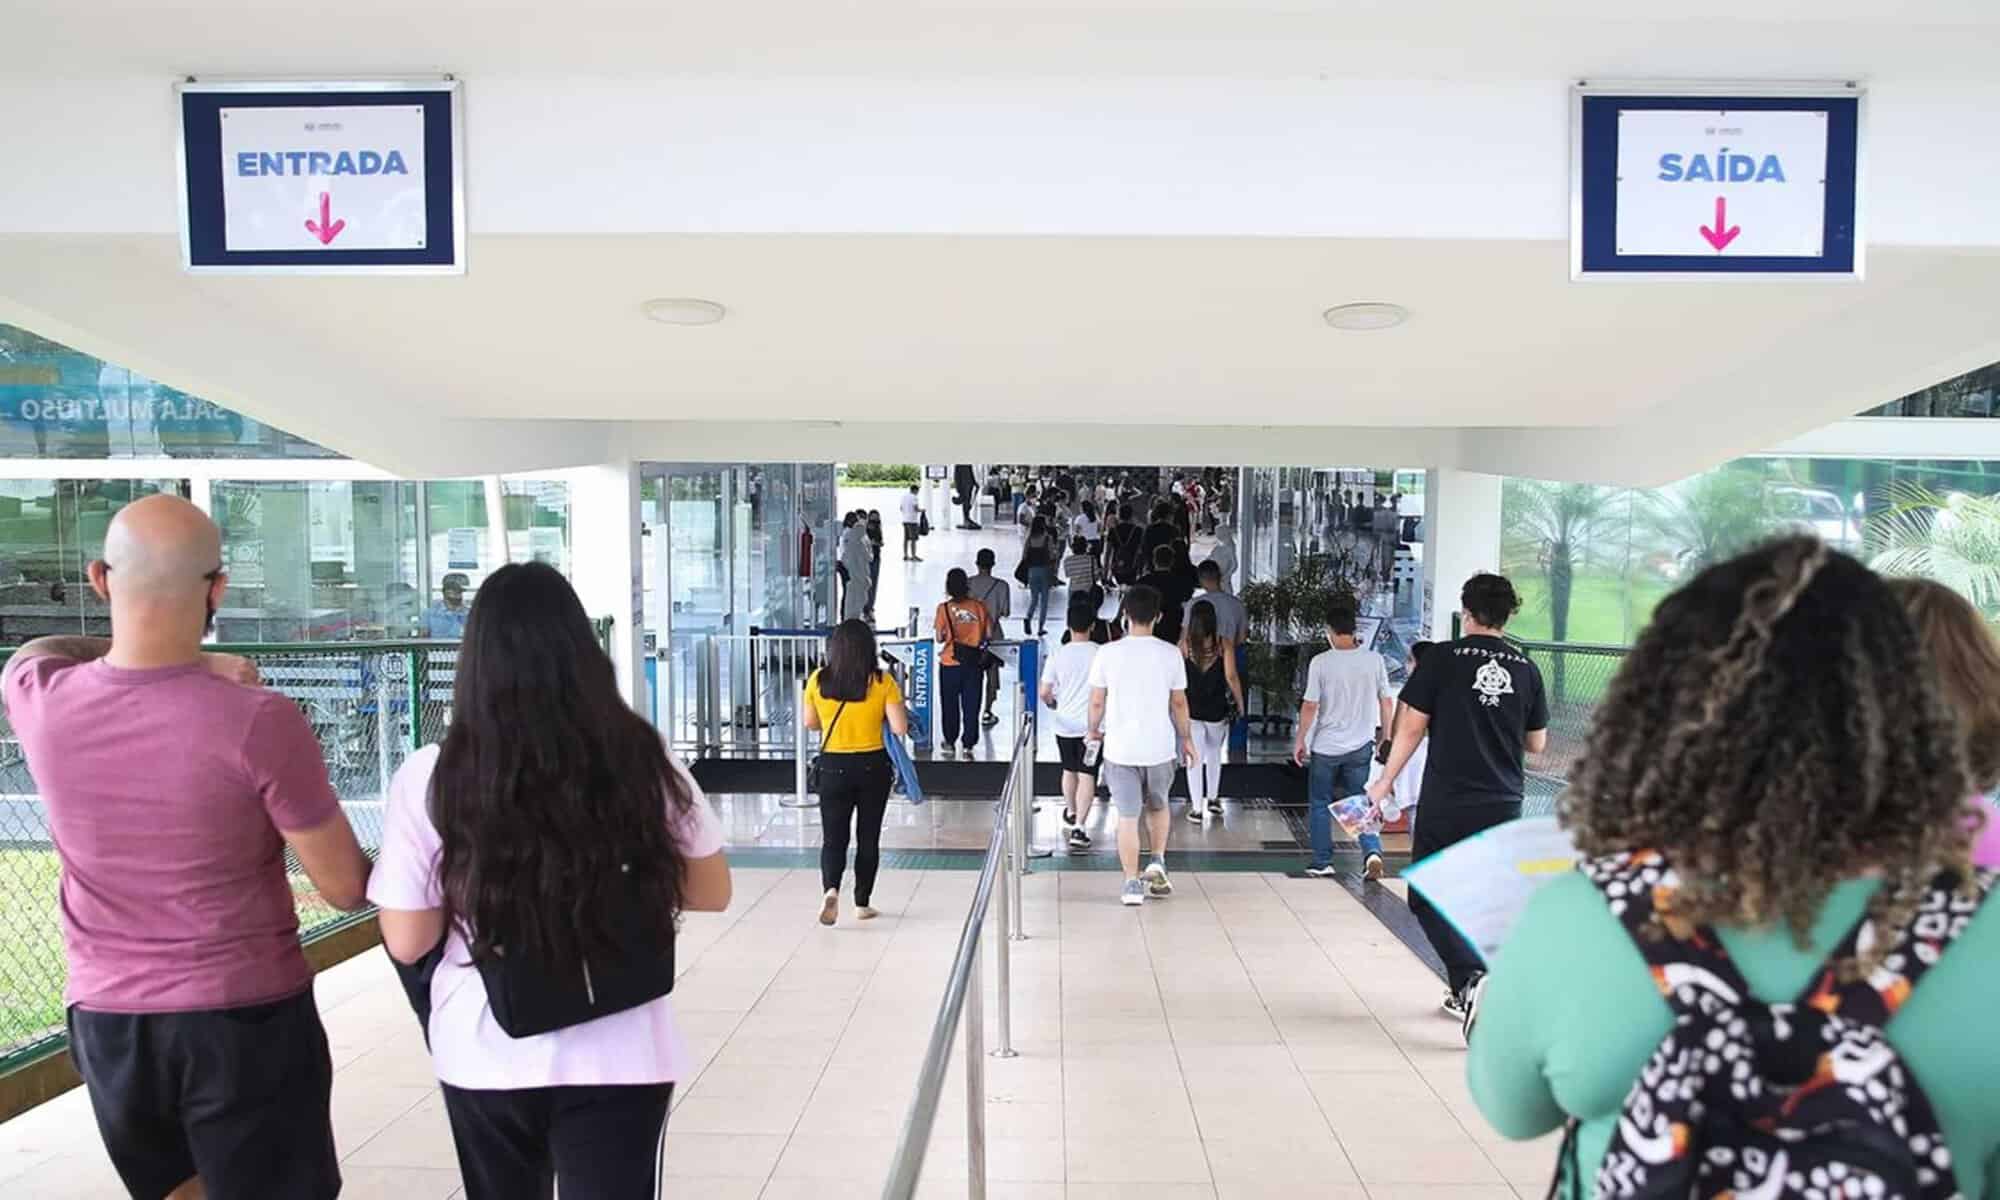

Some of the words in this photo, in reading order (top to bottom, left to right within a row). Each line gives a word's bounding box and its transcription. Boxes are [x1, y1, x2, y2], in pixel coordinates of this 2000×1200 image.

[237, 150, 408, 177] ENTRADA
[1658, 147, 1786, 183] SAÍDA
[915, 647, 928, 708] ENTRADA
